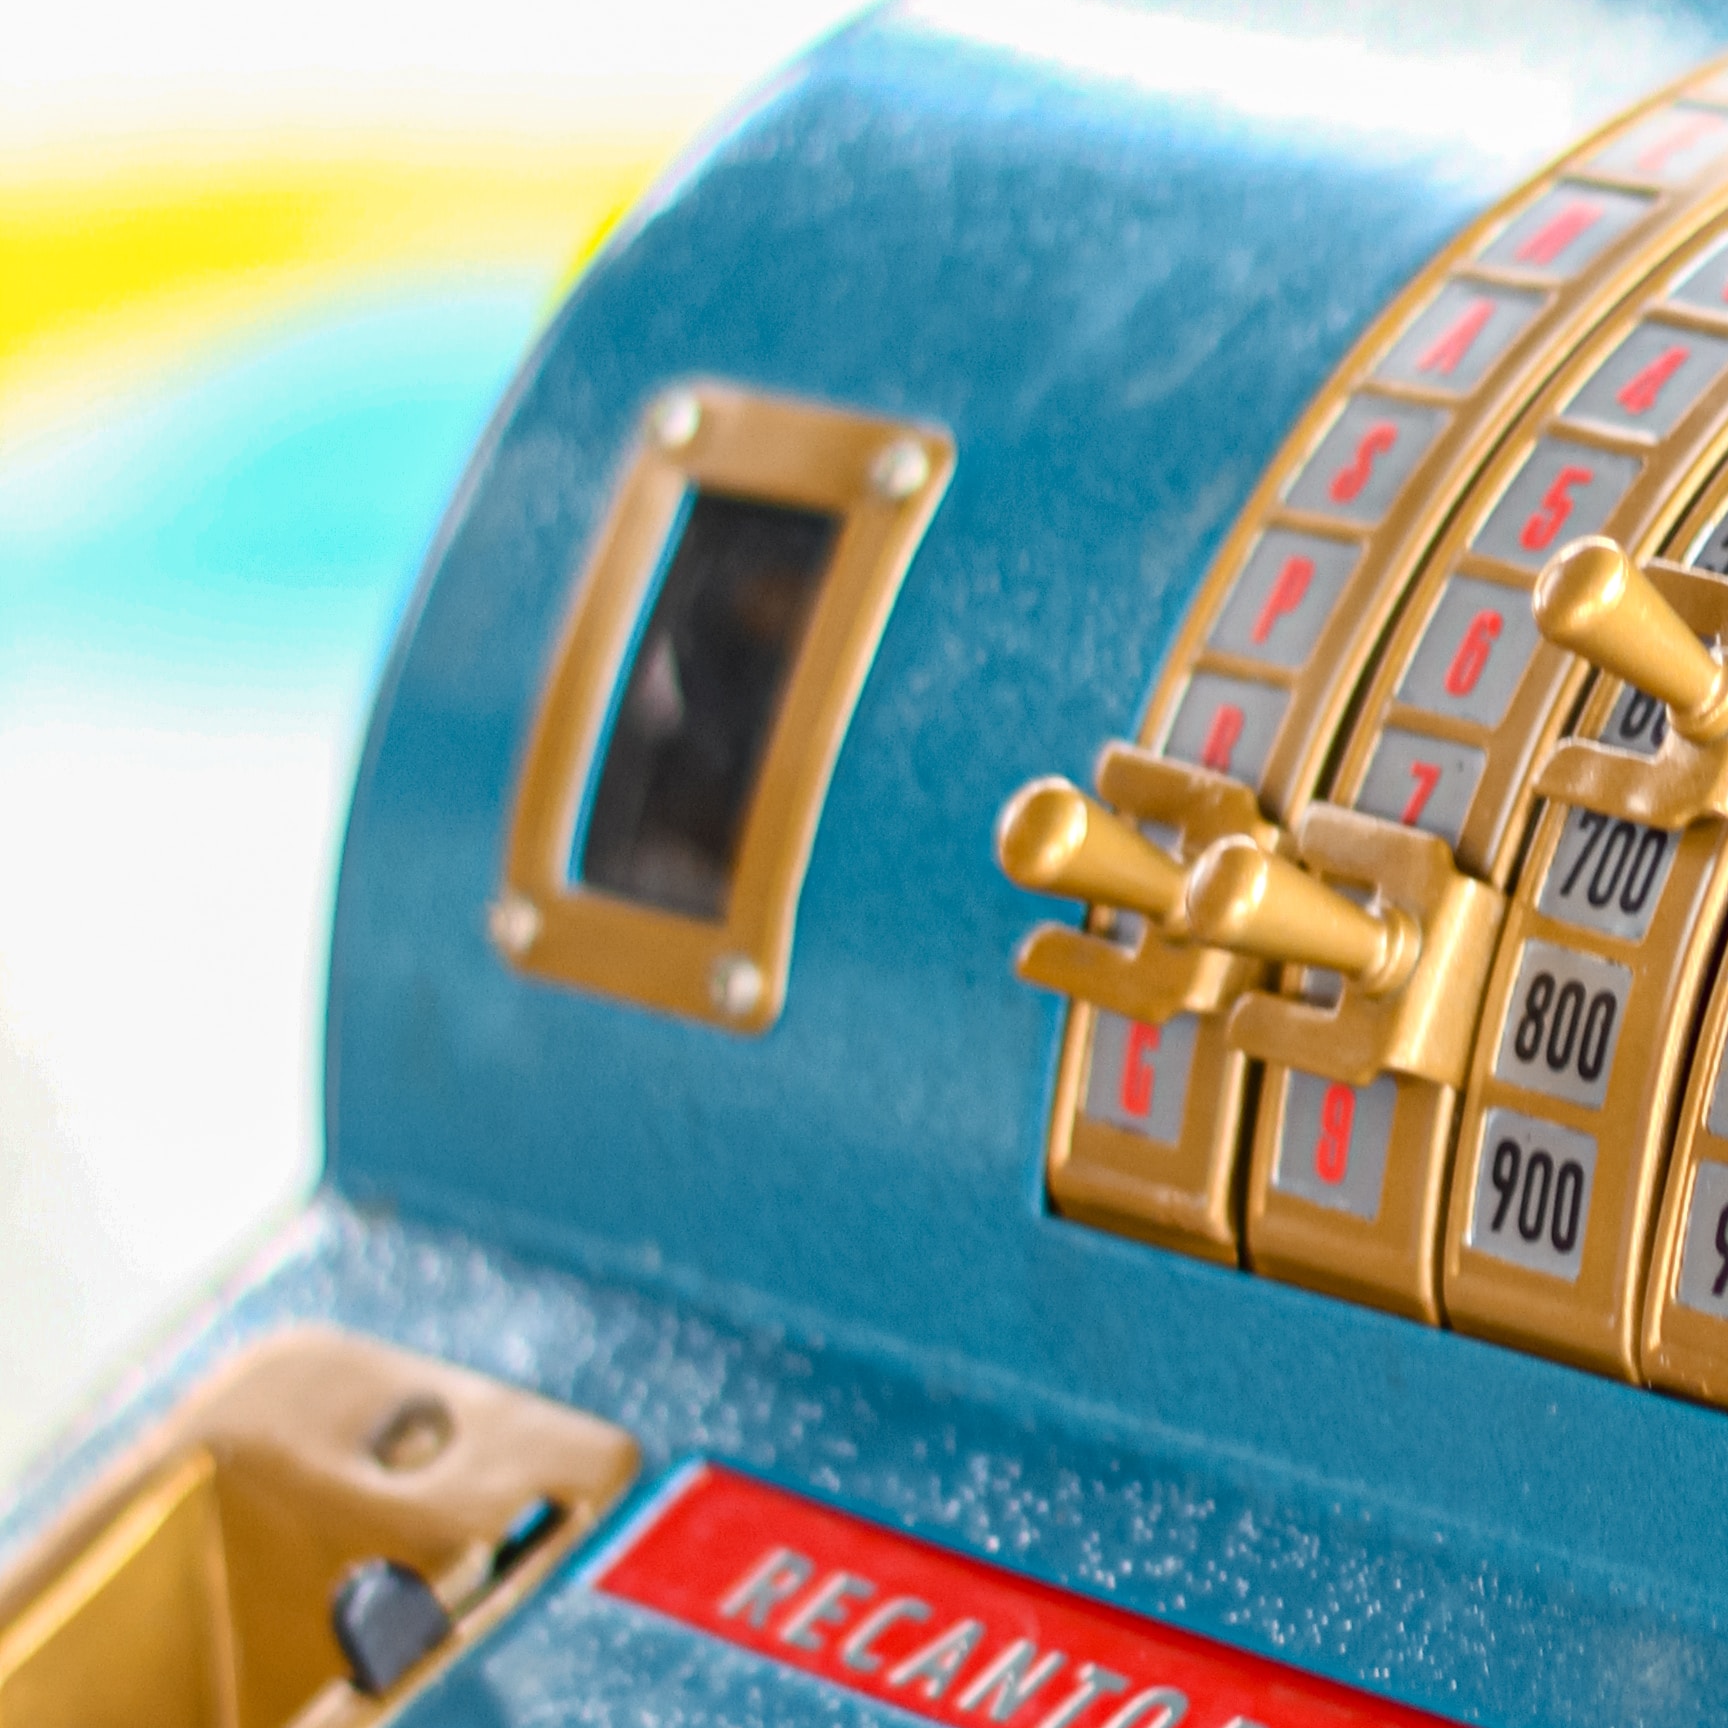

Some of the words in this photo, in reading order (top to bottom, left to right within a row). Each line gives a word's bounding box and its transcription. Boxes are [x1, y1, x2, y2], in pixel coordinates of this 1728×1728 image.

[1617, 346, 1690, 416] 4
[1519, 464, 1594, 552] 5
[1442, 608, 1505, 698] 6
[1558, 812, 1670, 915] 700
[1513, 971, 1619, 1083] 800
[1314, 1083, 1357, 1186] 9
[1489, 1136, 1586, 1256] 900
